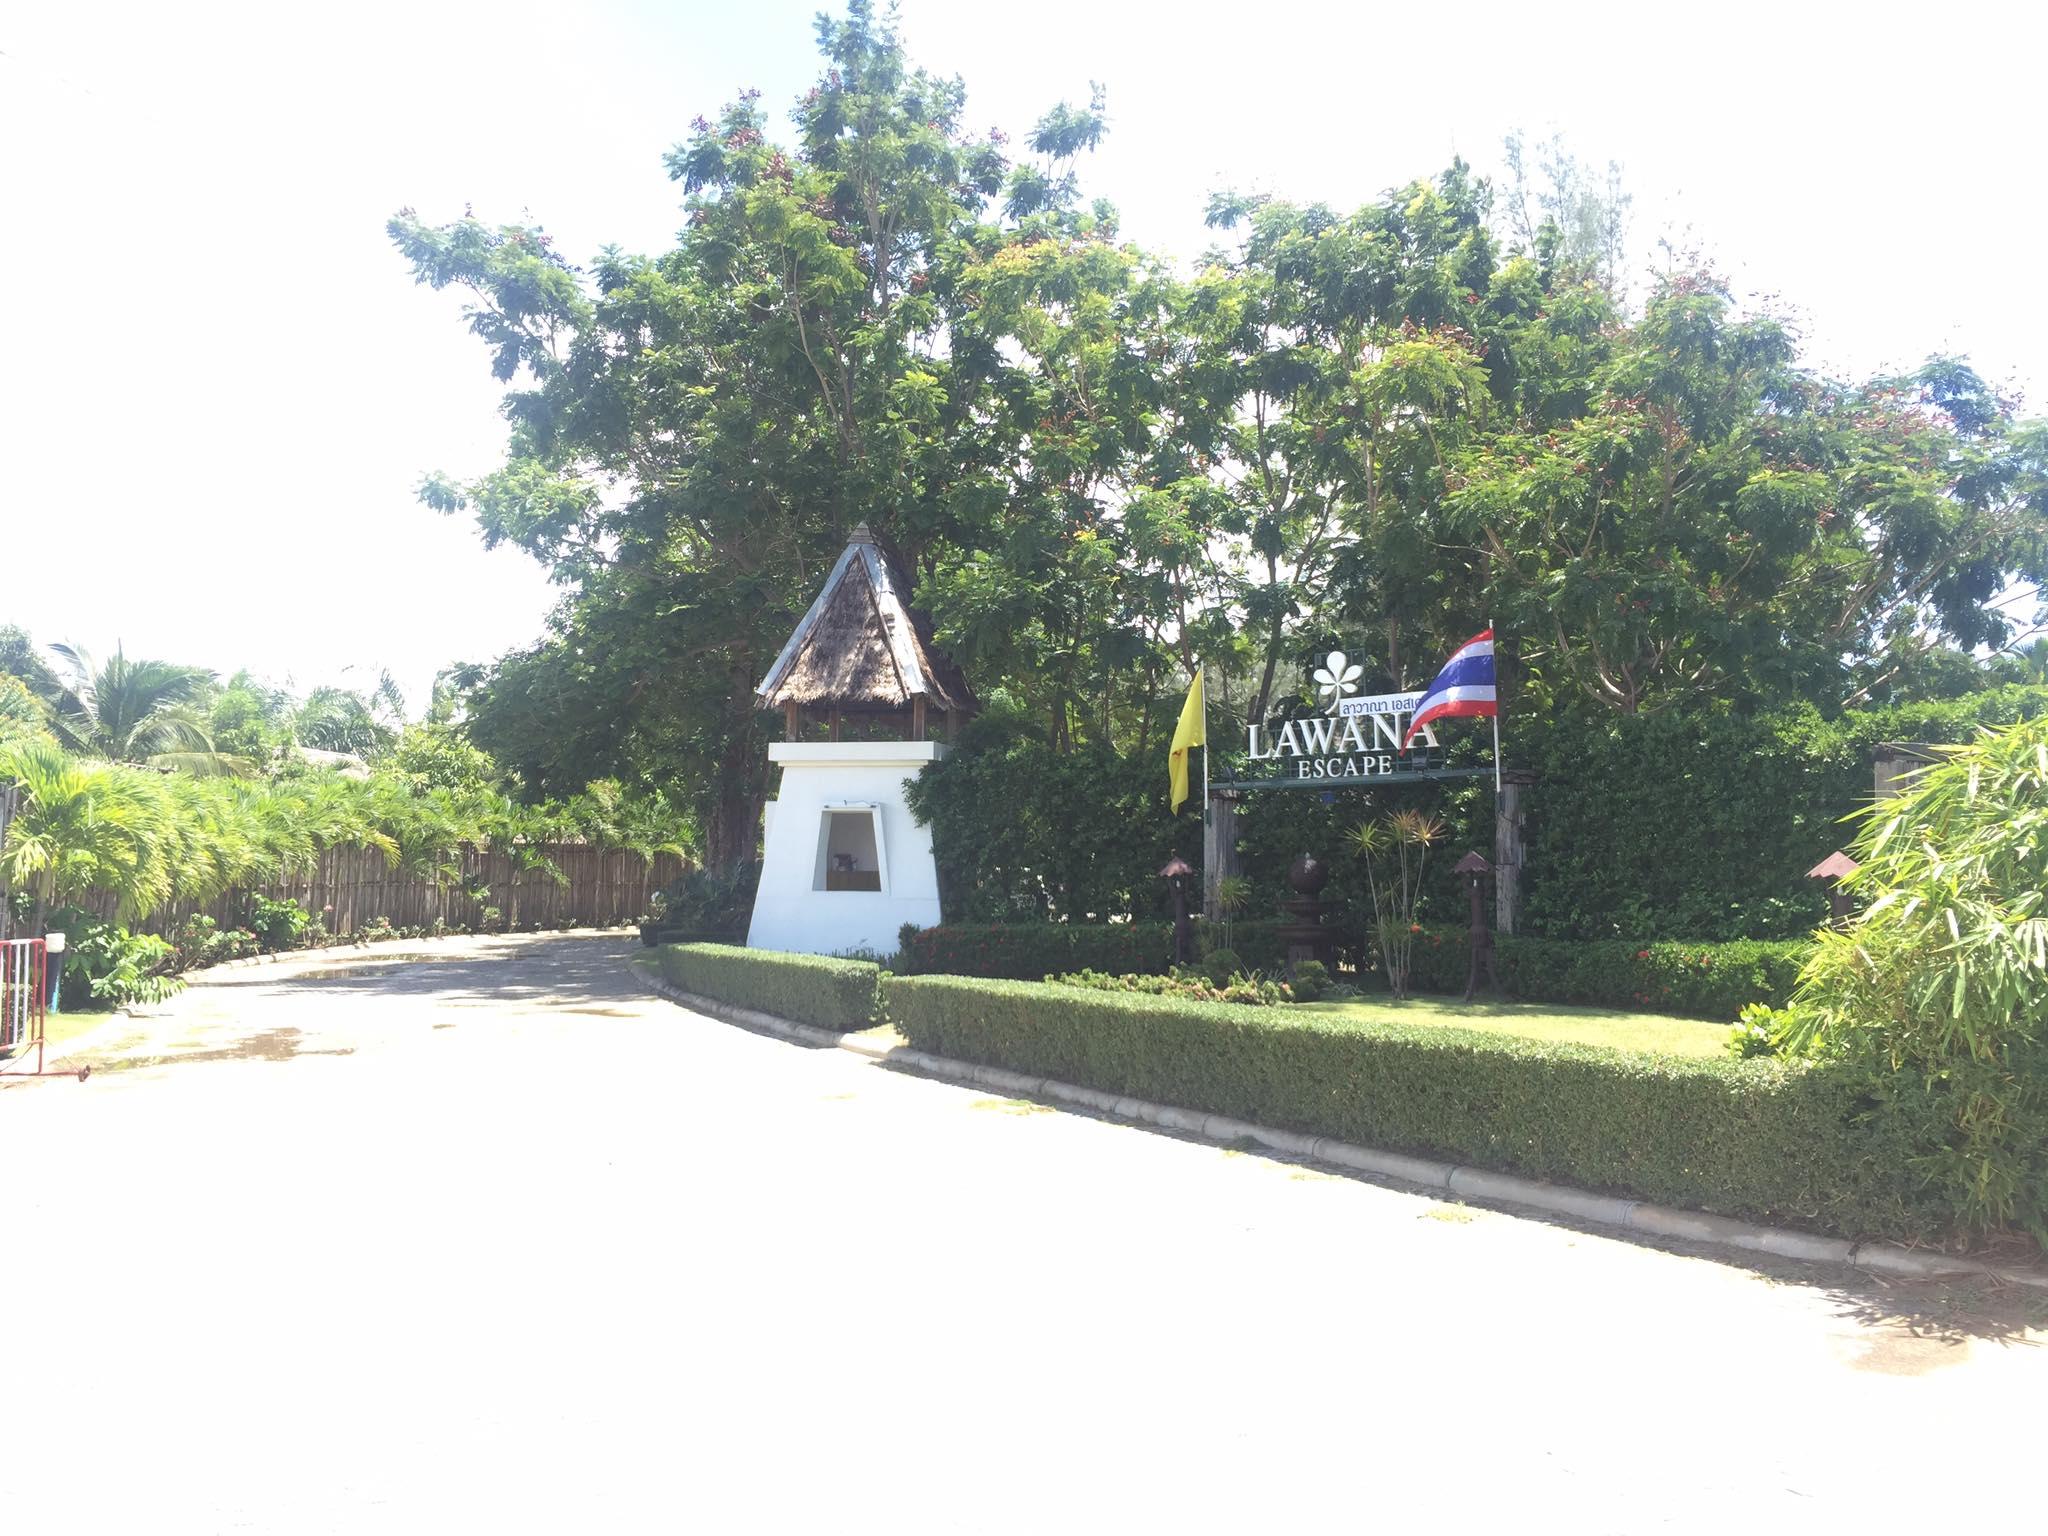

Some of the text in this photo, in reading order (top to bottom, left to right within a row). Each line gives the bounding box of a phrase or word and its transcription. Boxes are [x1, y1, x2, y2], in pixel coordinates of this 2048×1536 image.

[1342, 701, 1388, 715] ลาวาณา
[1247, 712, 1440, 760] LAWANA
[1298, 755, 1393, 779] ESCAPE
